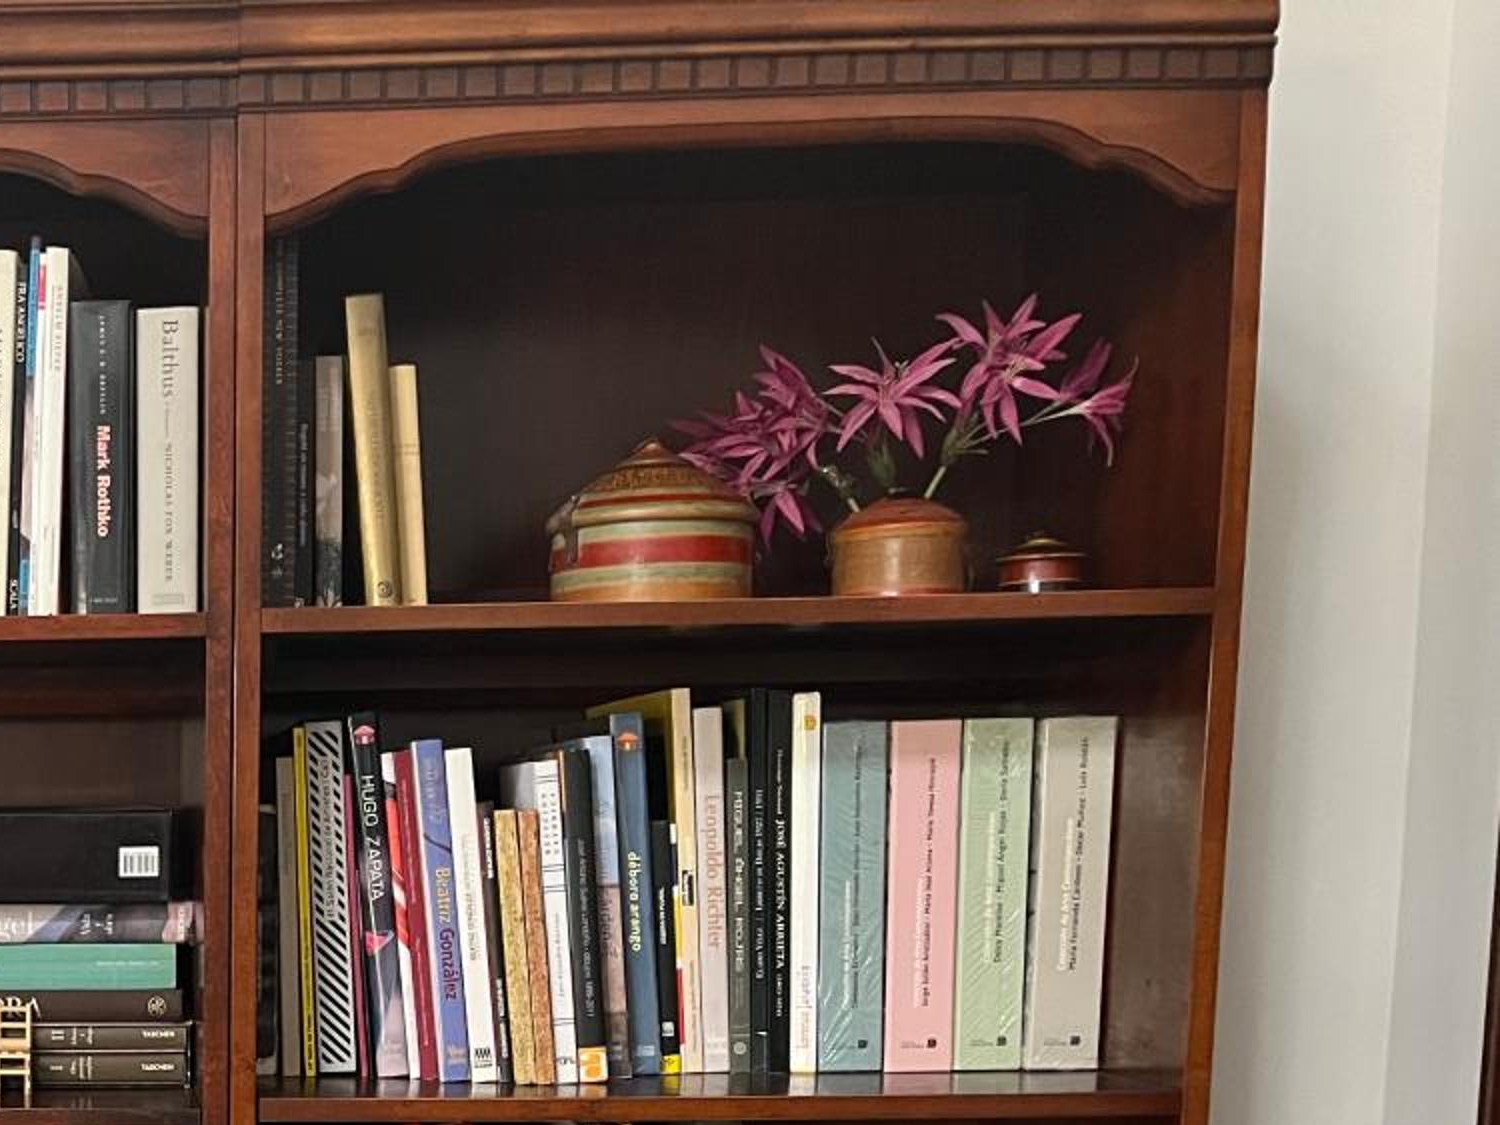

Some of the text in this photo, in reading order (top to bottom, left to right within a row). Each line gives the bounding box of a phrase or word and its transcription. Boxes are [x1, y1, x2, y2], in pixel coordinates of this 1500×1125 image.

[15, 282, 26, 363] FRA ANGELICO
[96, 425, 111, 537] Mark Rothko
[161, 320, 179, 582] Balthus NICHOLAS FOX WEBER
[9, 579, 18, 609] SCALA
[361, 775, 384, 900] HUGO ZAPATA
[702, 794, 721, 948] Leopoldo Richter
[733, 791, 743, 853] MIGUEL
[435, 867, 458, 1000] Beatriz González
[627, 852, 642, 952] débora arango
[734, 917, 744, 971] ROJAS
[775, 819, 787, 969] JOSÉ AGUSTÍN ARRIETA
